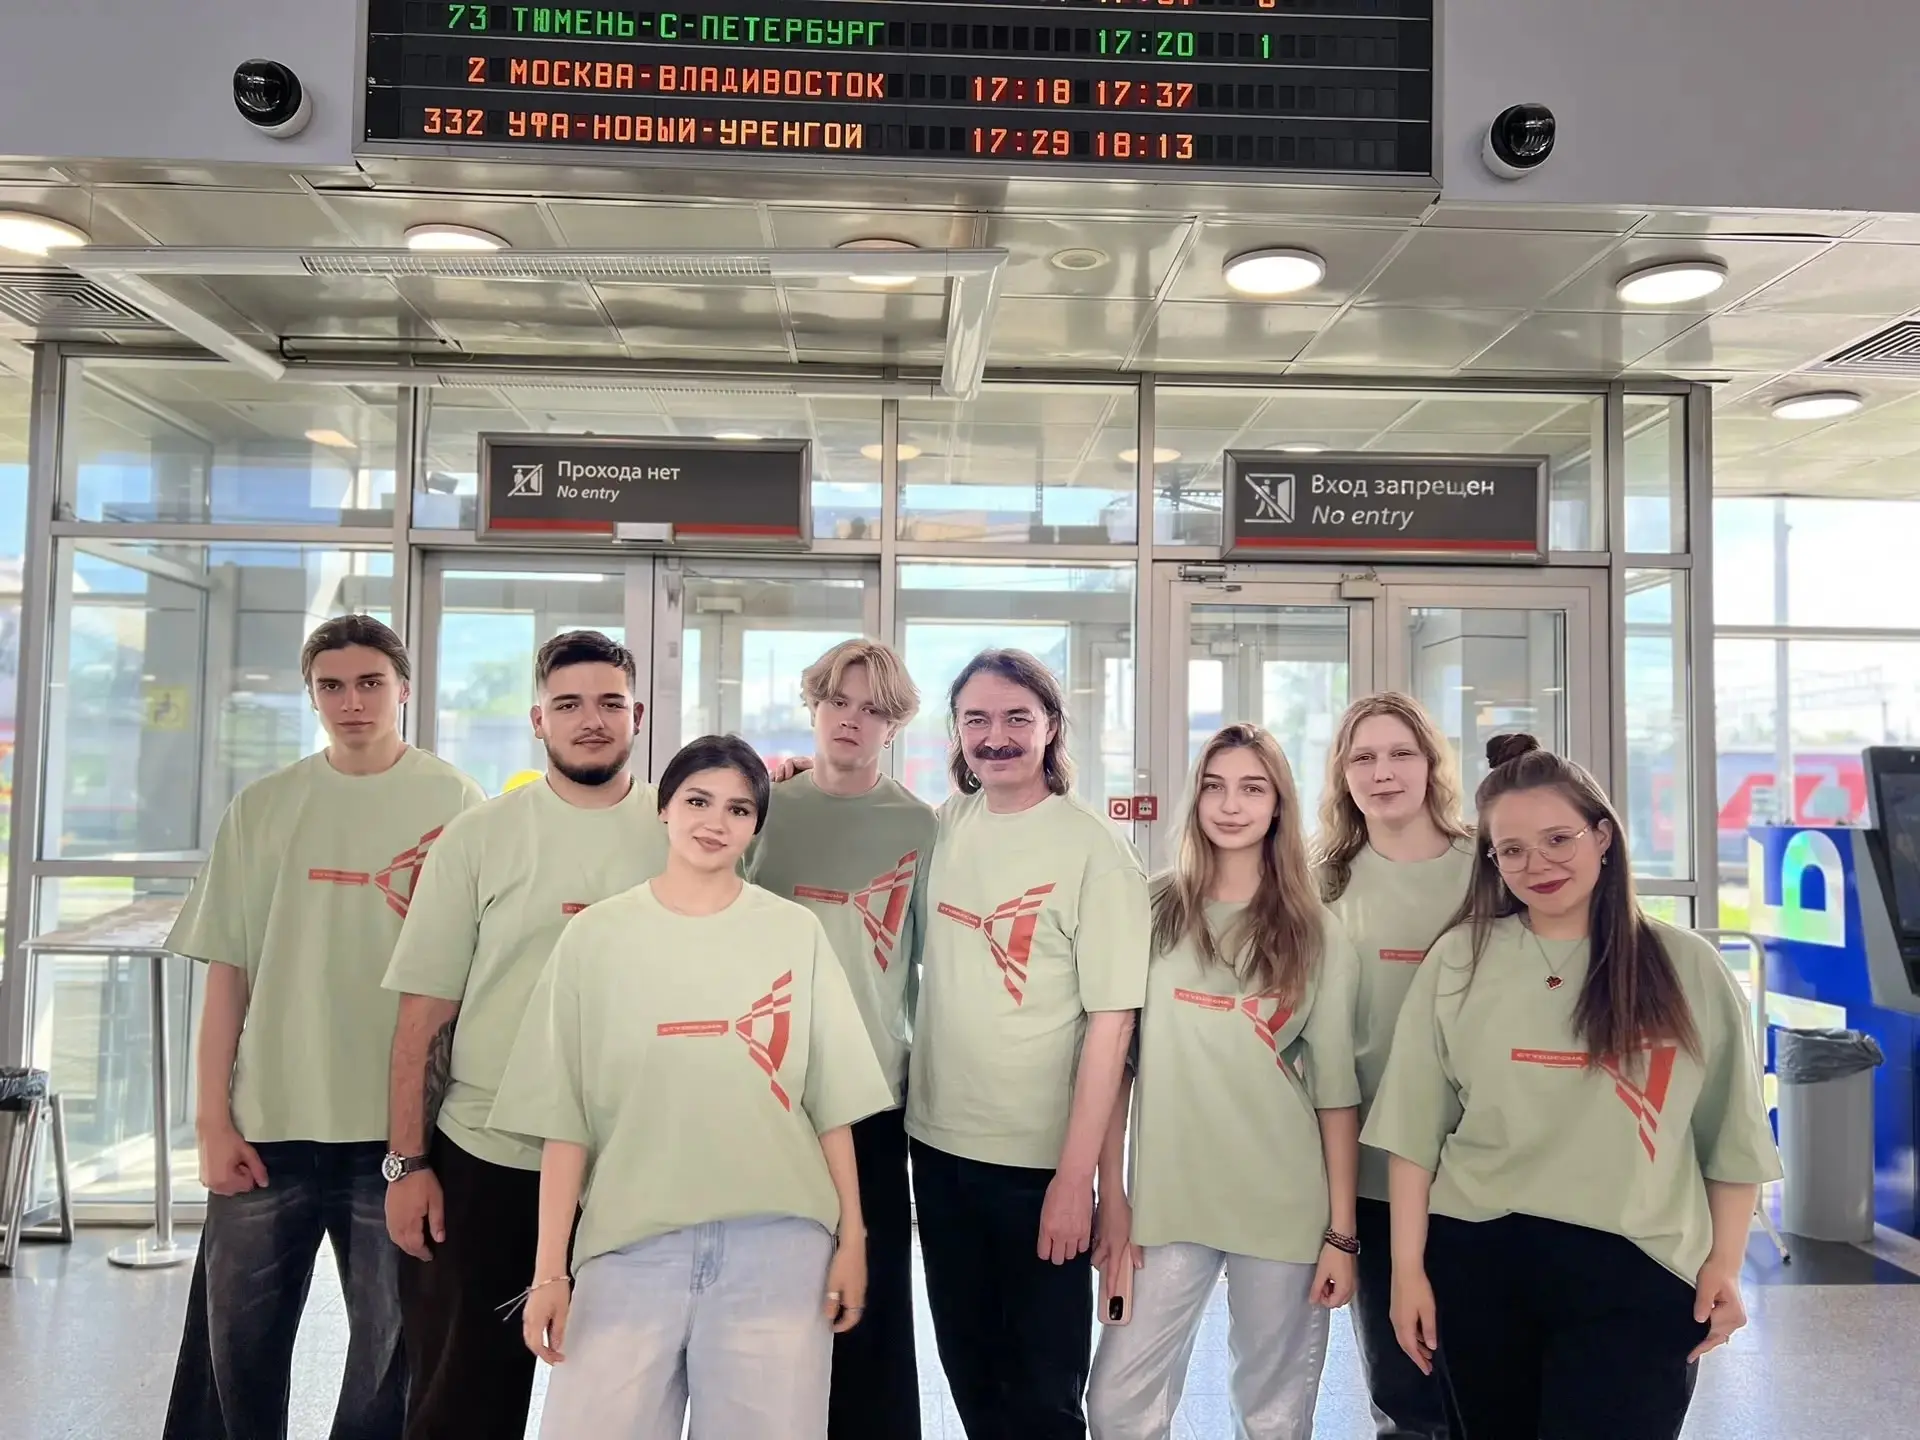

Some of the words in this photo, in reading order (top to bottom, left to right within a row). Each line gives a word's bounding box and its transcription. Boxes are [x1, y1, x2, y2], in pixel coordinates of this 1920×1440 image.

[449, 4, 486, 30] 73
[512, 7, 885, 46] ТЮМЕНЬ-С-ПЕТЕРБУРГ
[1099, 30, 1194, 57] 17:20
[1260, 34, 1270, 59] 1
[468, 57, 485, 83] 2
[510, 58, 884, 98] МОСКВА-ВЛАДИВОСТОК
[974, 76, 1070, 104] 17:18
[1097, 80, 1193, 107] 17:37
[424, 107, 484, 135] 332
[508, 111, 862, 149] УФА-НОВЫЙ-УРЕНГОЙ
[973, 128, 1070, 156] 17:29
[1097, 131, 1193, 159] 18:13
[558, 460, 642, 482] Прохода
[647, 467, 681, 481] нет
[556, 485, 578, 499] No
[580, 488, 620, 503] entry
[1311, 474, 1368, 498] Вход
[1374, 479, 1495, 501] запрещен
[1311, 505, 1345, 525] No
[1351, 507, 1414, 531] entry
